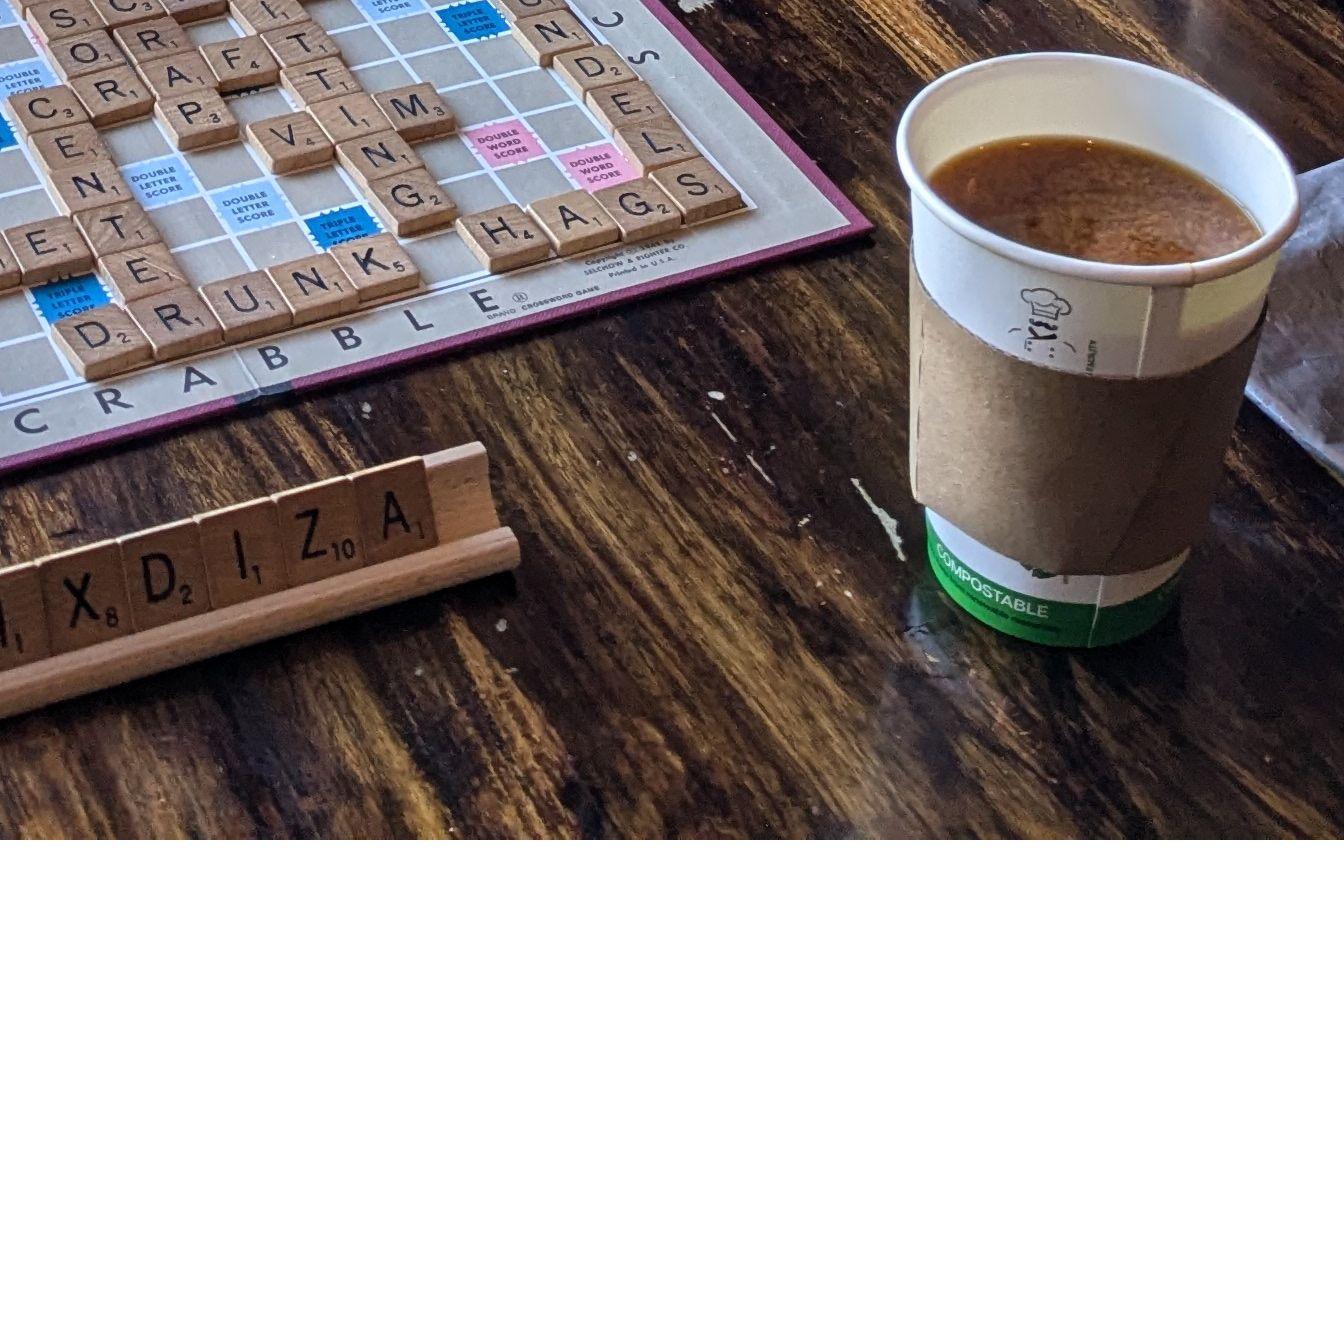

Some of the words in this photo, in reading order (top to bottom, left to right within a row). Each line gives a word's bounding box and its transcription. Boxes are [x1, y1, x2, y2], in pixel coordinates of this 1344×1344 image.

[376, 1, 412, 13] SCORE
[475, 129, 519, 144] DOUBLE
[486, 138, 522, 151] WORD
[493, 145, 530, 159] SCORE
[221, 191, 267, 207] DOUBLE
[230, 200, 269, 215] LETTER
[236, 208, 276, 223] SCORE
[521, 292, 573, 311] CROSSWORD
[576, 285, 600, 297] GAME
[936, 542, 1049, 619] COMPOSTABLE
